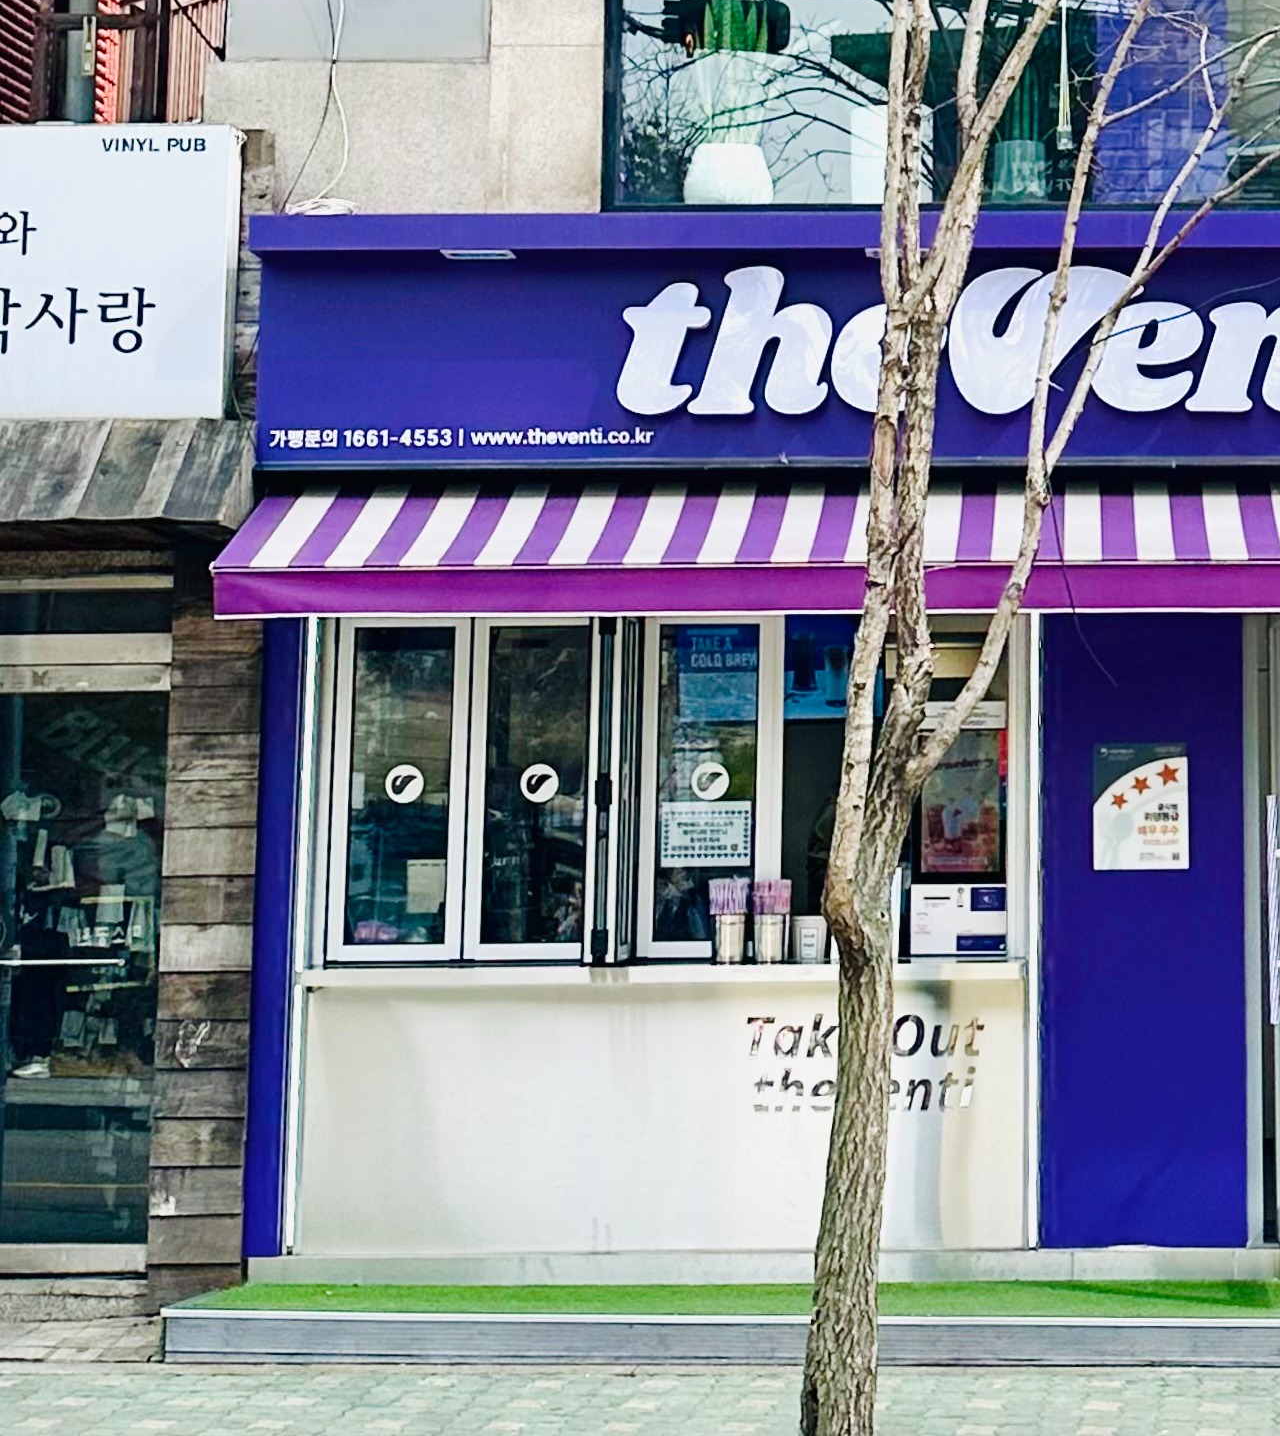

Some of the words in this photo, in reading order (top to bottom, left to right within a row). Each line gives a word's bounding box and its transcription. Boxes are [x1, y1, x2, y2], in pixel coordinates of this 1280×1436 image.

[101, 137, 160, 152] VINYL
[167, 137, 207, 152] PUB
[269, 429, 338, 448] 가맹문의
[343, 429, 453, 447] 1661-4553
[471, 427, 654, 446] www.theventi.co.kr
[691, 636, 721, 652] TAKE
[724, 636, 733, 652] A
[691, 653, 722, 668] COLD
[747, 1014, 839, 1058] Tak
[892, 1014, 985, 1057] Out
[754, 1066, 976, 1112] theenti
